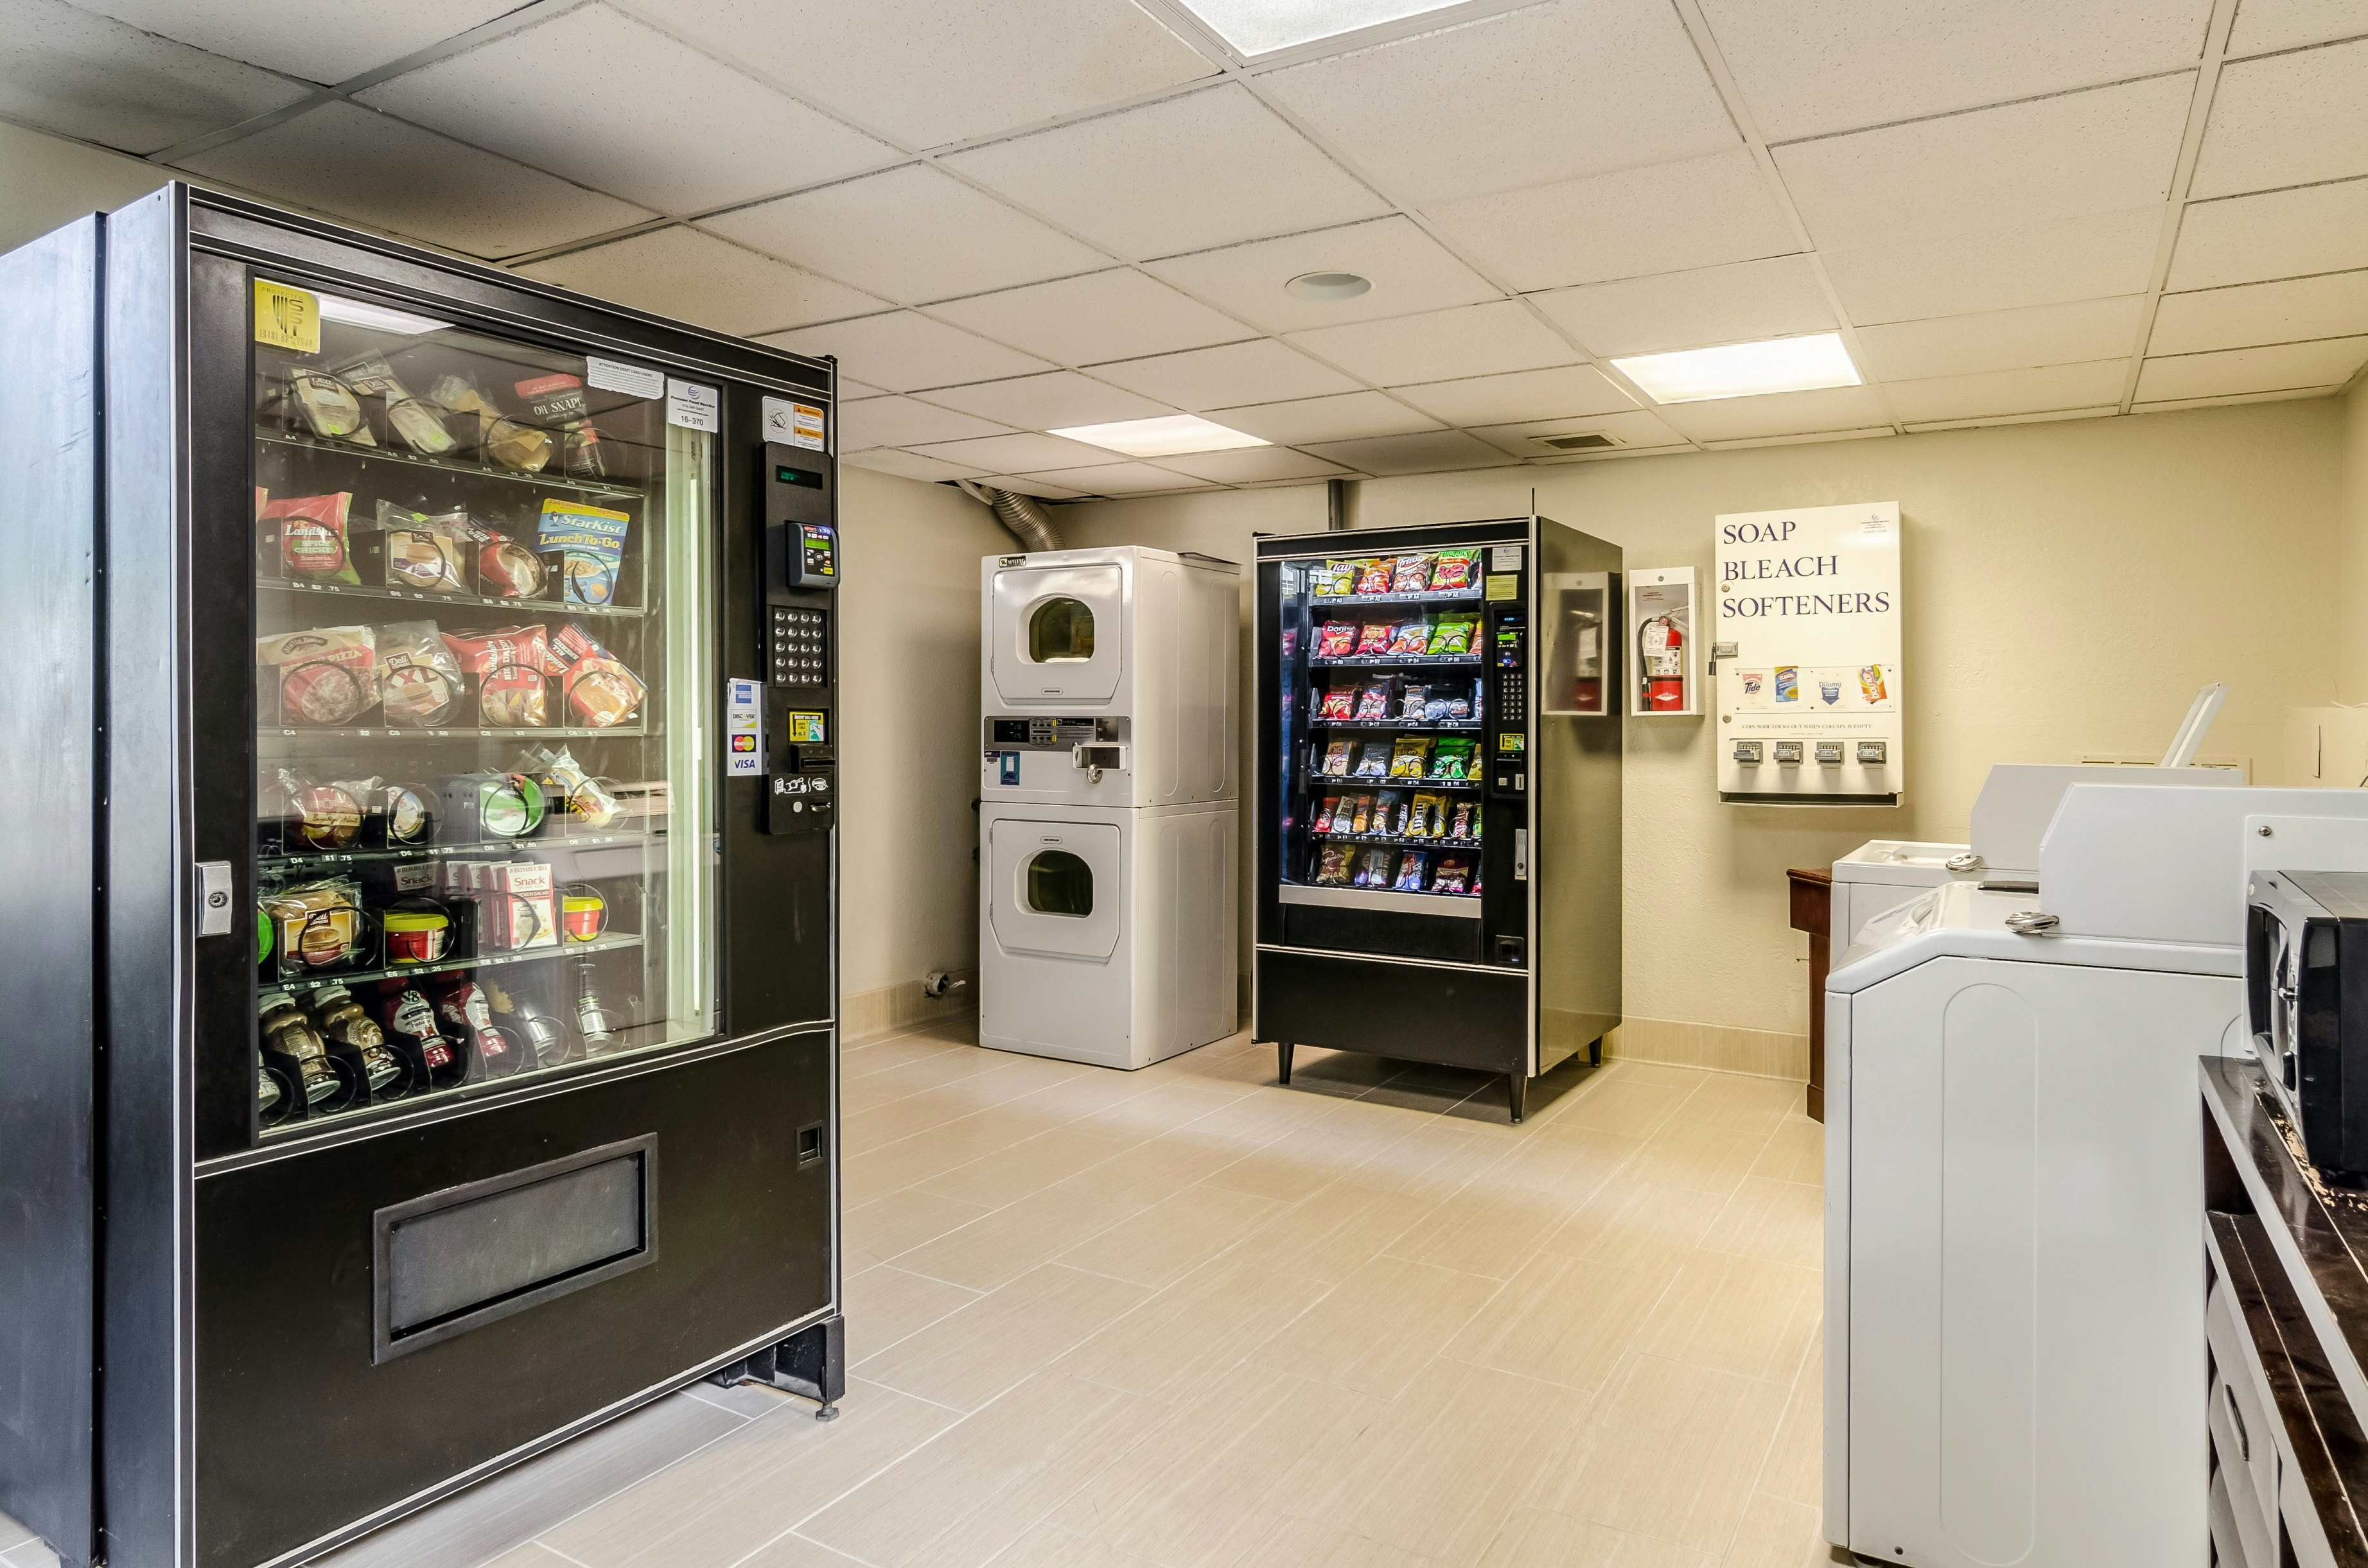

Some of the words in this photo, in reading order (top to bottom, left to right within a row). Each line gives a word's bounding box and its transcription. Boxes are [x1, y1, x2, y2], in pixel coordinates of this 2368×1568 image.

[261, 286, 303, 300] PROTECTED
[533, 405, 548, 416] OH
[550, 397, 582, 414] SNAP!
[681, 415, 704, 426] 16-370
[560, 514, 622, 534] StarKist
[539, 532, 582, 545] Lunch
[1723, 521, 1796, 544] SOAP
[1723, 555, 1839, 581] BLEACH
[1722, 591, 1890, 618] SOFTENERS
[389, 656, 408, 666] Deli
[395, 668, 439, 683] XL
[1744, 681, 1761, 694] Tide
[734, 759, 755, 769] VISA
[401, 874, 434, 885] Snack
[514, 876, 545, 887] Snack
[401, 990, 420, 1002] V8
